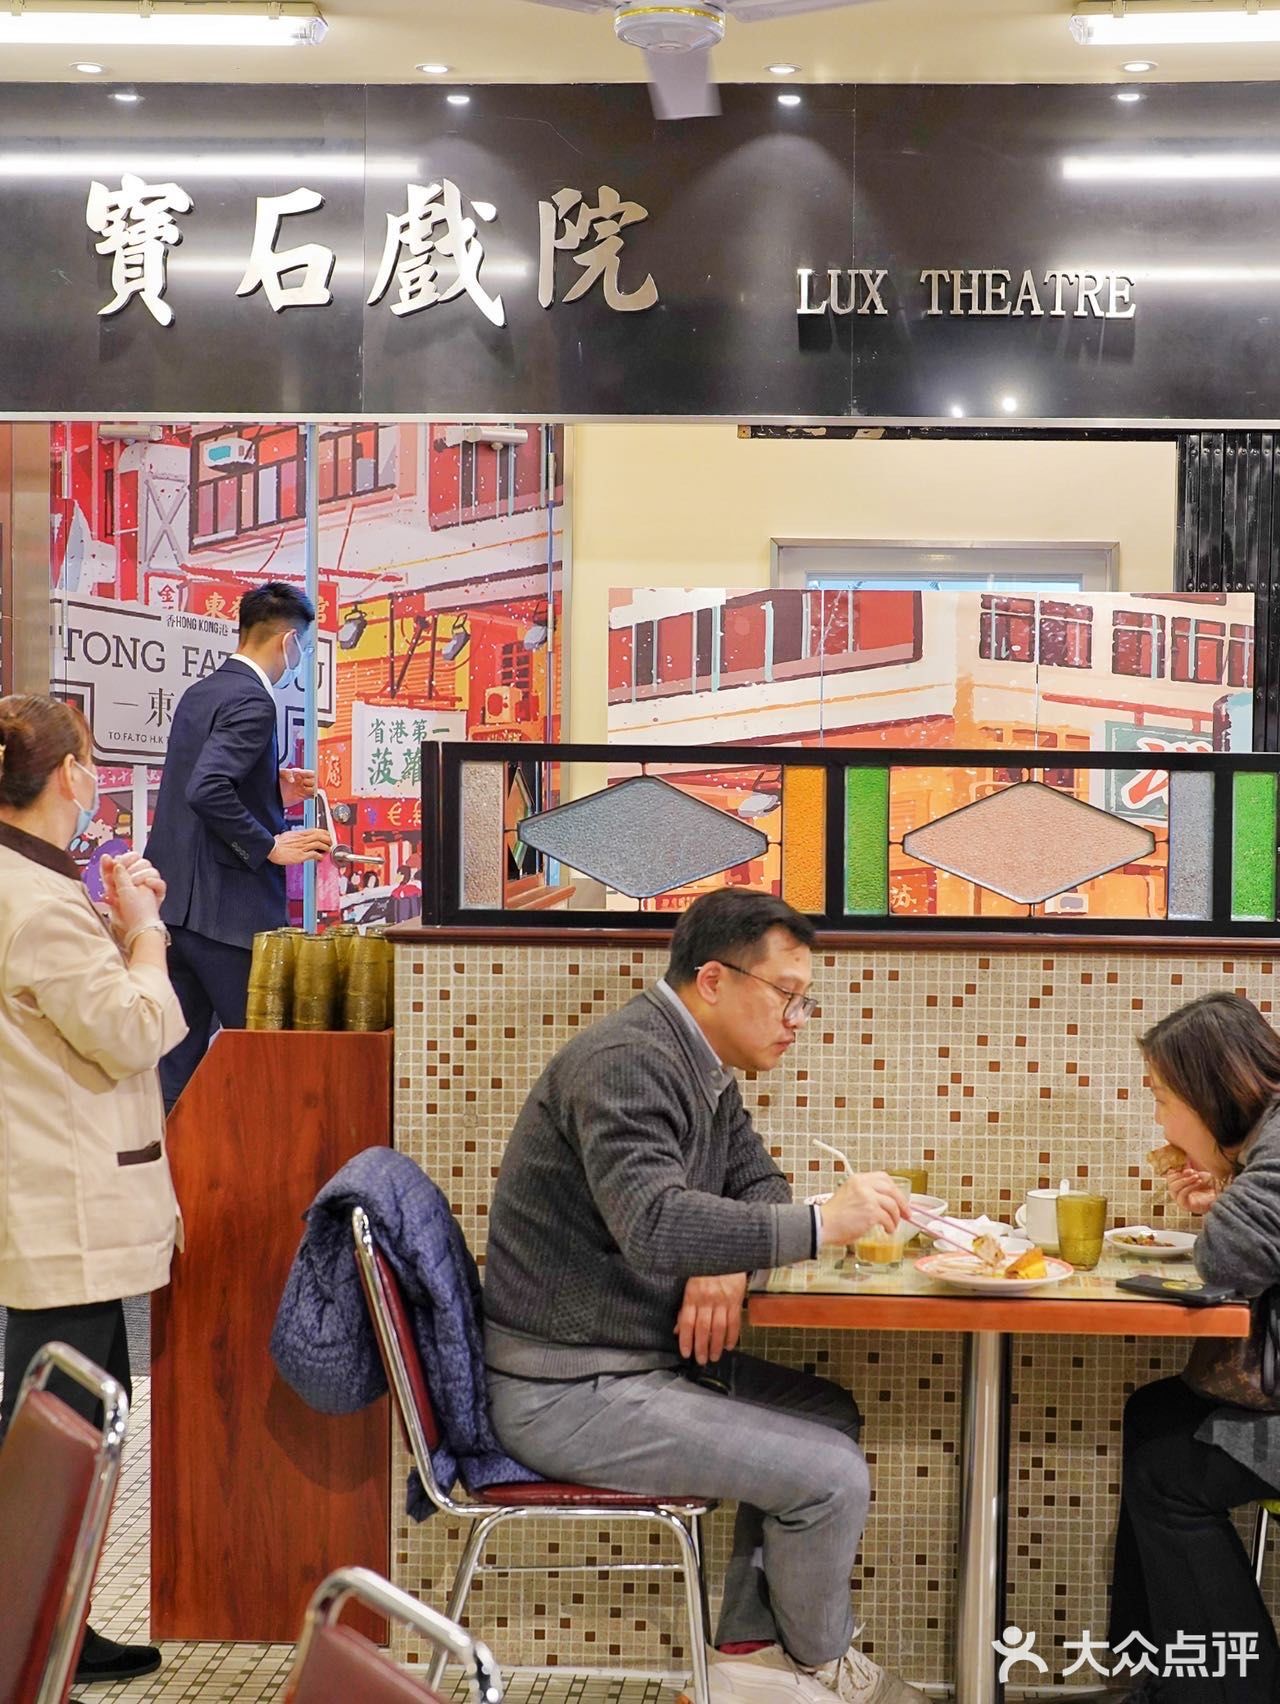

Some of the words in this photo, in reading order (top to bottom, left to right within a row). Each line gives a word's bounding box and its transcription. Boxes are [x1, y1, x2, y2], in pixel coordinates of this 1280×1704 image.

[86, 173, 659, 327] 寶石戲院
[796, 267, 888, 316] LUX
[919, 268, 1137, 319] THEATRE
[59, 626, 166, 673] TONG
[368, 718, 450, 745] 省港第一
